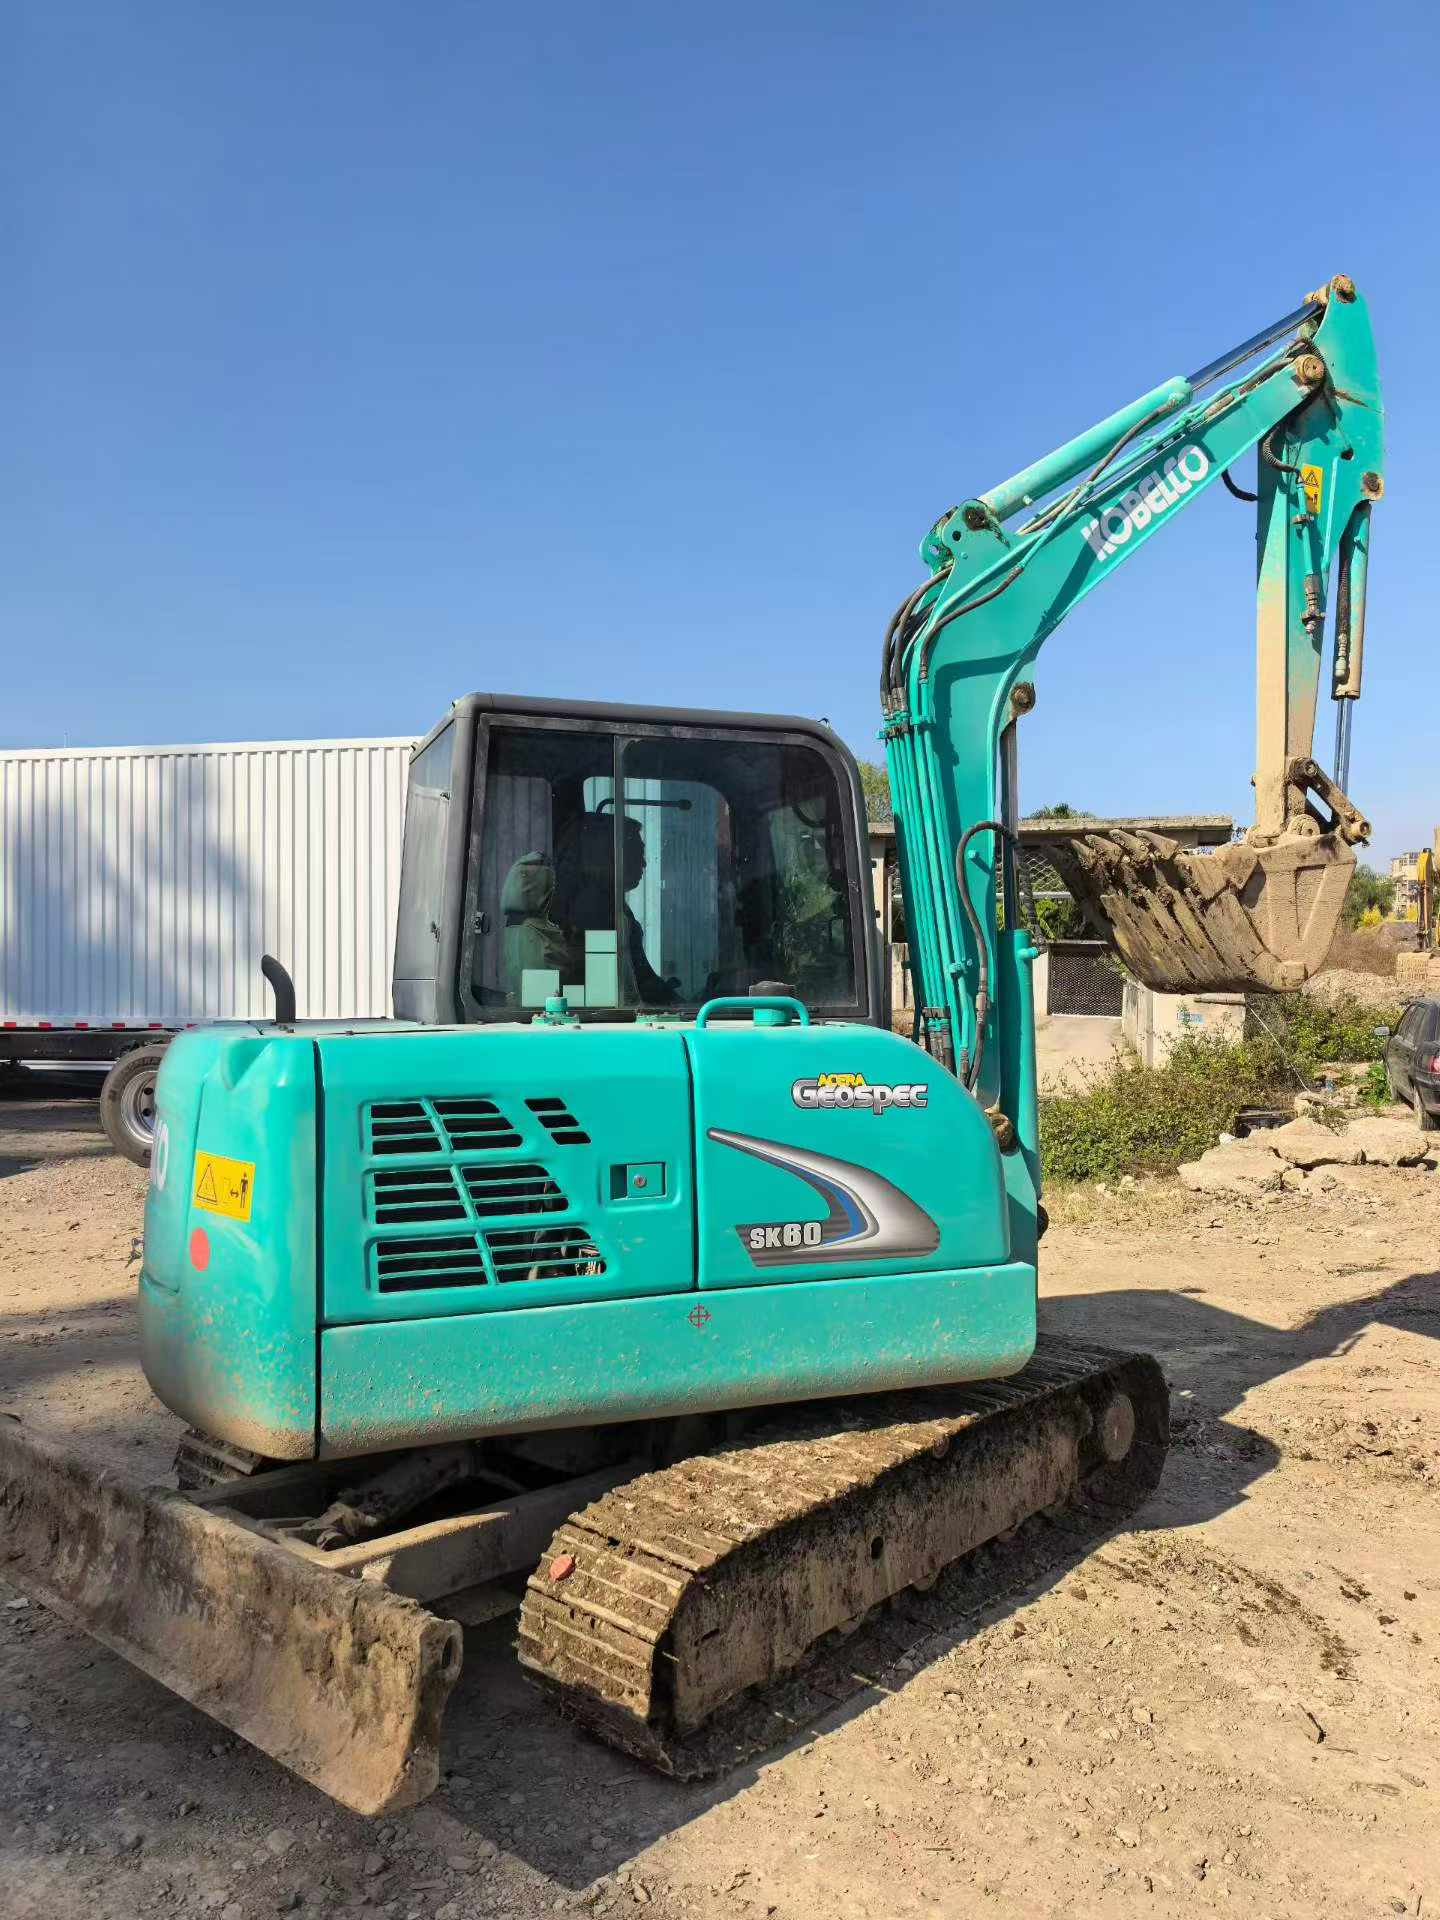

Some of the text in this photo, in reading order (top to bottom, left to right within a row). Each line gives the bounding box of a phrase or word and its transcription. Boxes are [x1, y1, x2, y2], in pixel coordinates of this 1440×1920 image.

[1080, 444, 1209, 561] KOBELCO
[818, 1073, 866, 1087] ACERA
[750, 1222, 822, 1249] SK60
